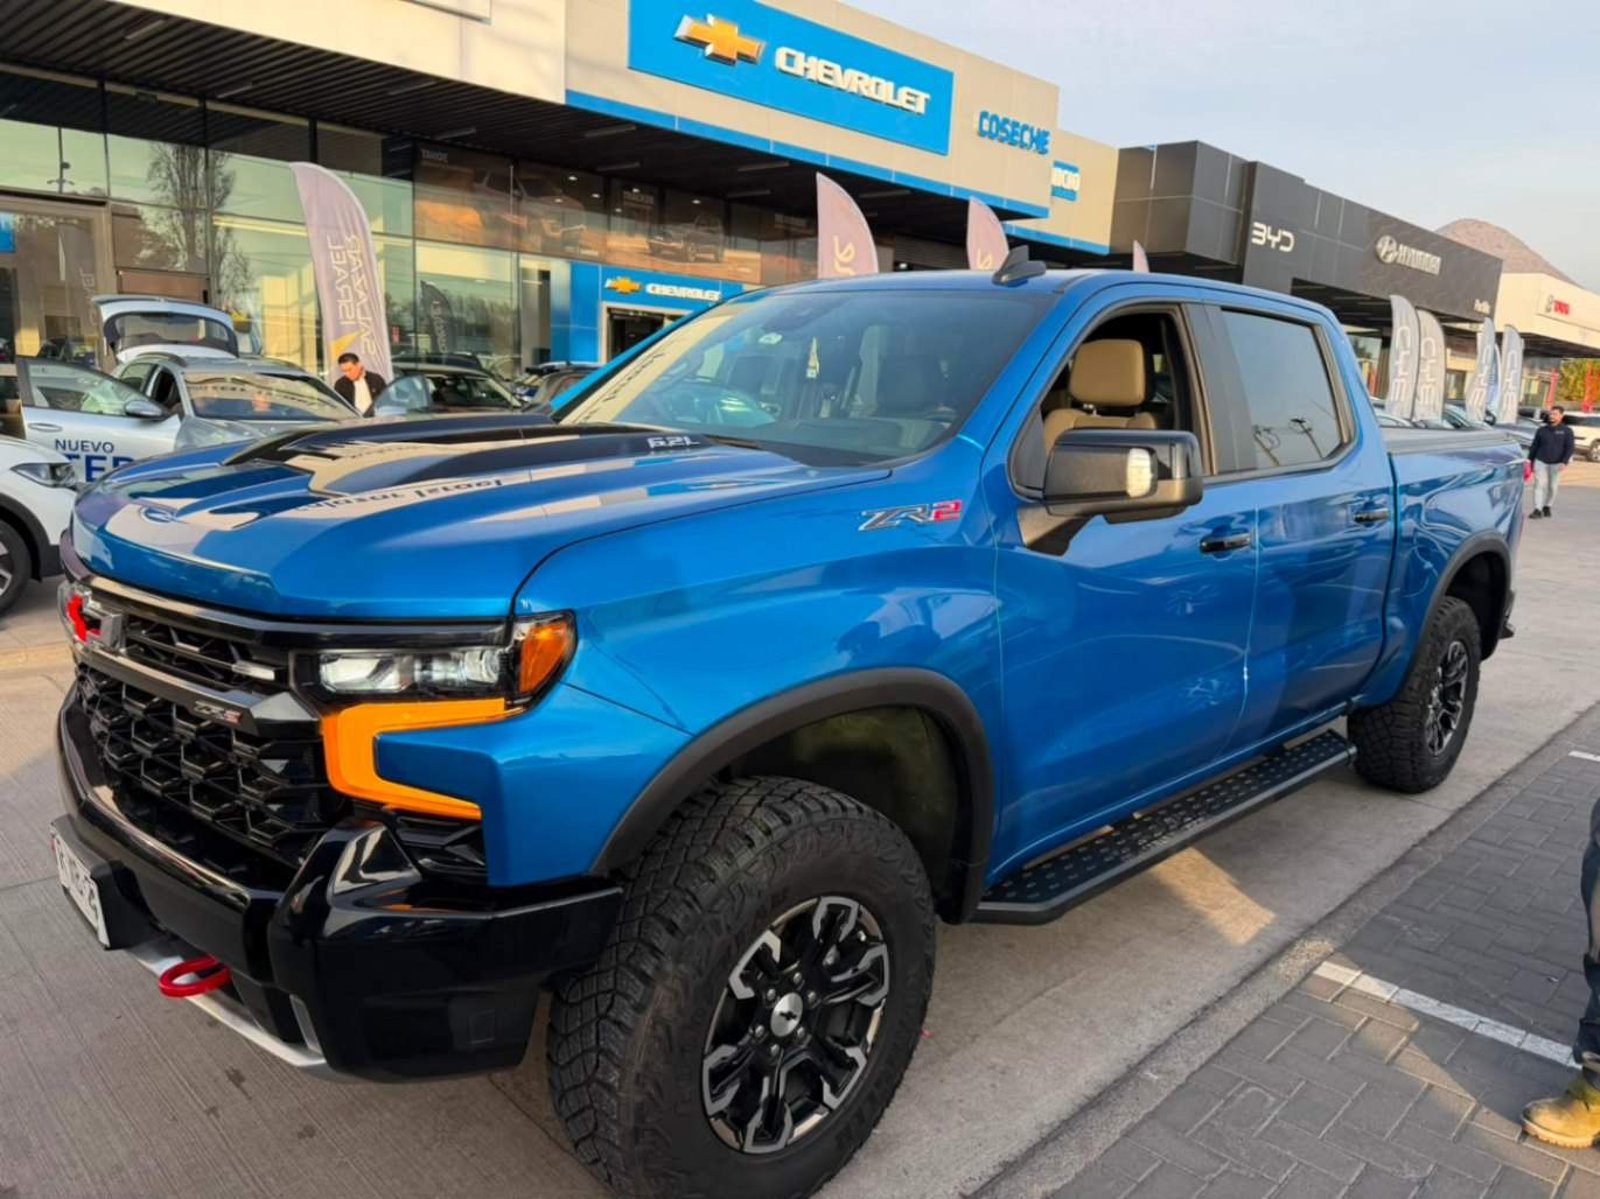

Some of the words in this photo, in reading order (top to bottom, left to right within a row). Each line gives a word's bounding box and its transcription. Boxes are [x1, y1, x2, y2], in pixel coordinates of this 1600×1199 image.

[775, 47, 930, 114] CHEVROLET
[978, 111, 1050, 155] COSECHE
[1251, 221, 1295, 252] BYD
[55, 439, 114, 453] NUEVO
[859, 499, 963, 531] ZR2
